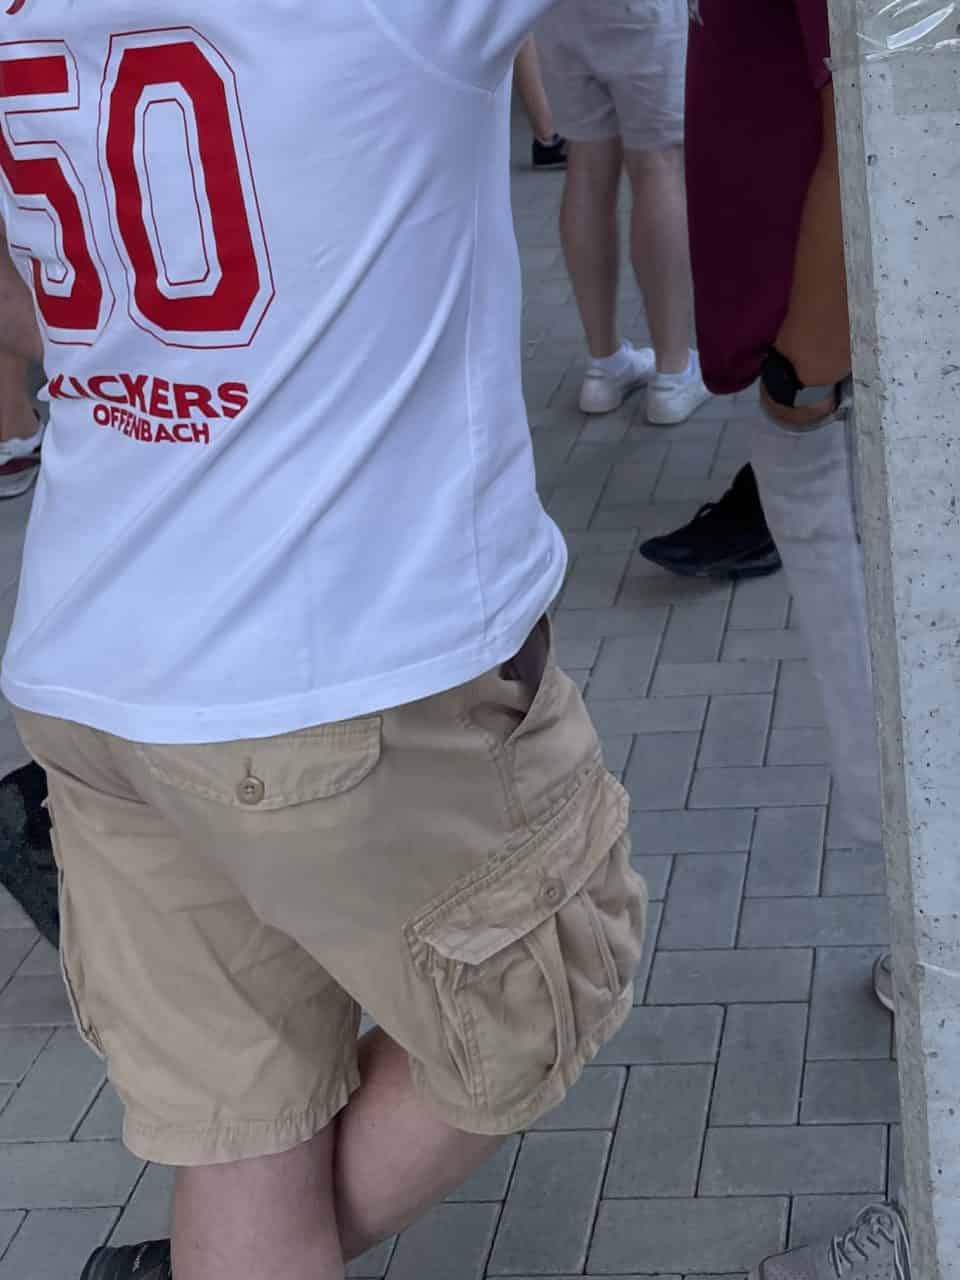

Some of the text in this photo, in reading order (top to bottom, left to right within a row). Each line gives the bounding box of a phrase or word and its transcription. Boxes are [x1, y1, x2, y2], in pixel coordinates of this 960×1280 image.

[0, 26, 275, 349] 50
[48, 373, 248, 419] KICKERS
[93, 404, 209, 444] OFFENBACH
